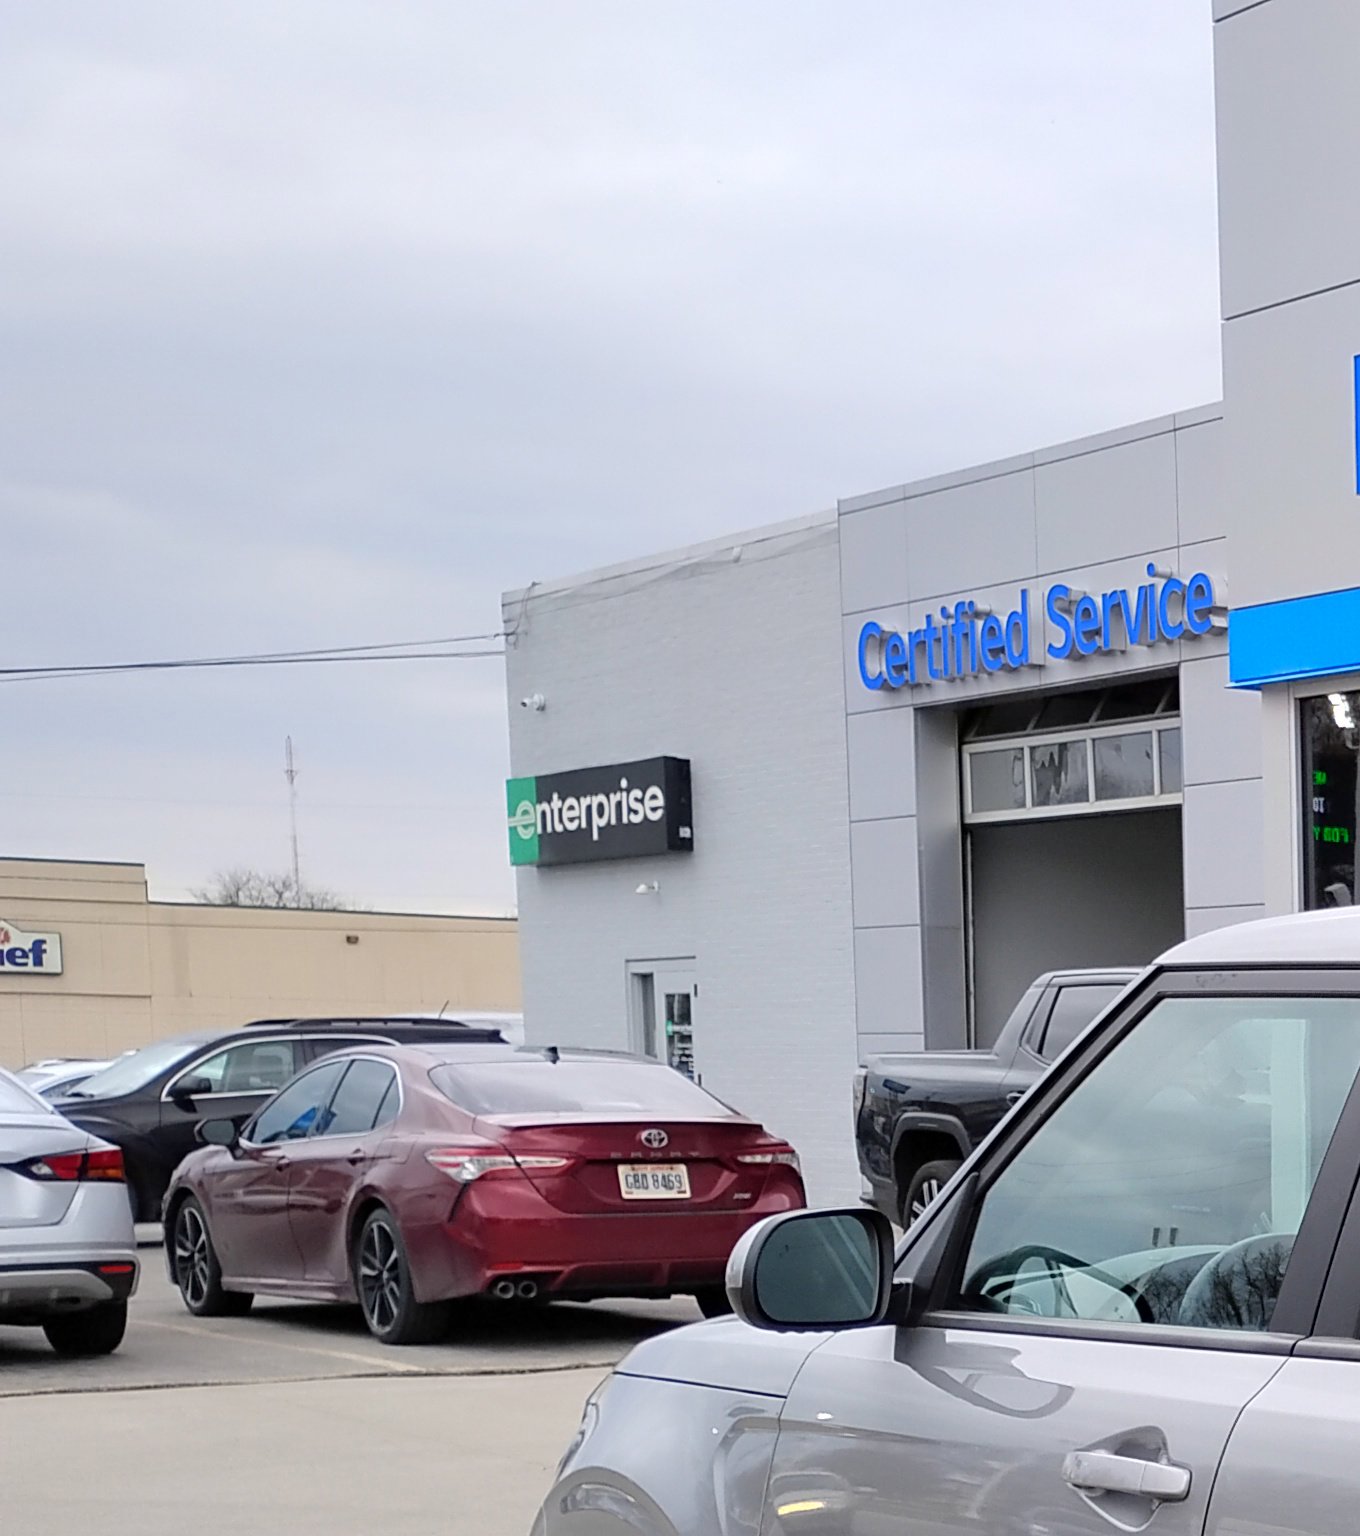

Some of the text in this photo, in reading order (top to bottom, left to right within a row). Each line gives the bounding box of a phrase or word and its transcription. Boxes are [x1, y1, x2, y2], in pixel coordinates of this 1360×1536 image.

[858, 562, 1220, 692] Certified Service
[508, 777, 665, 841] enterprise
